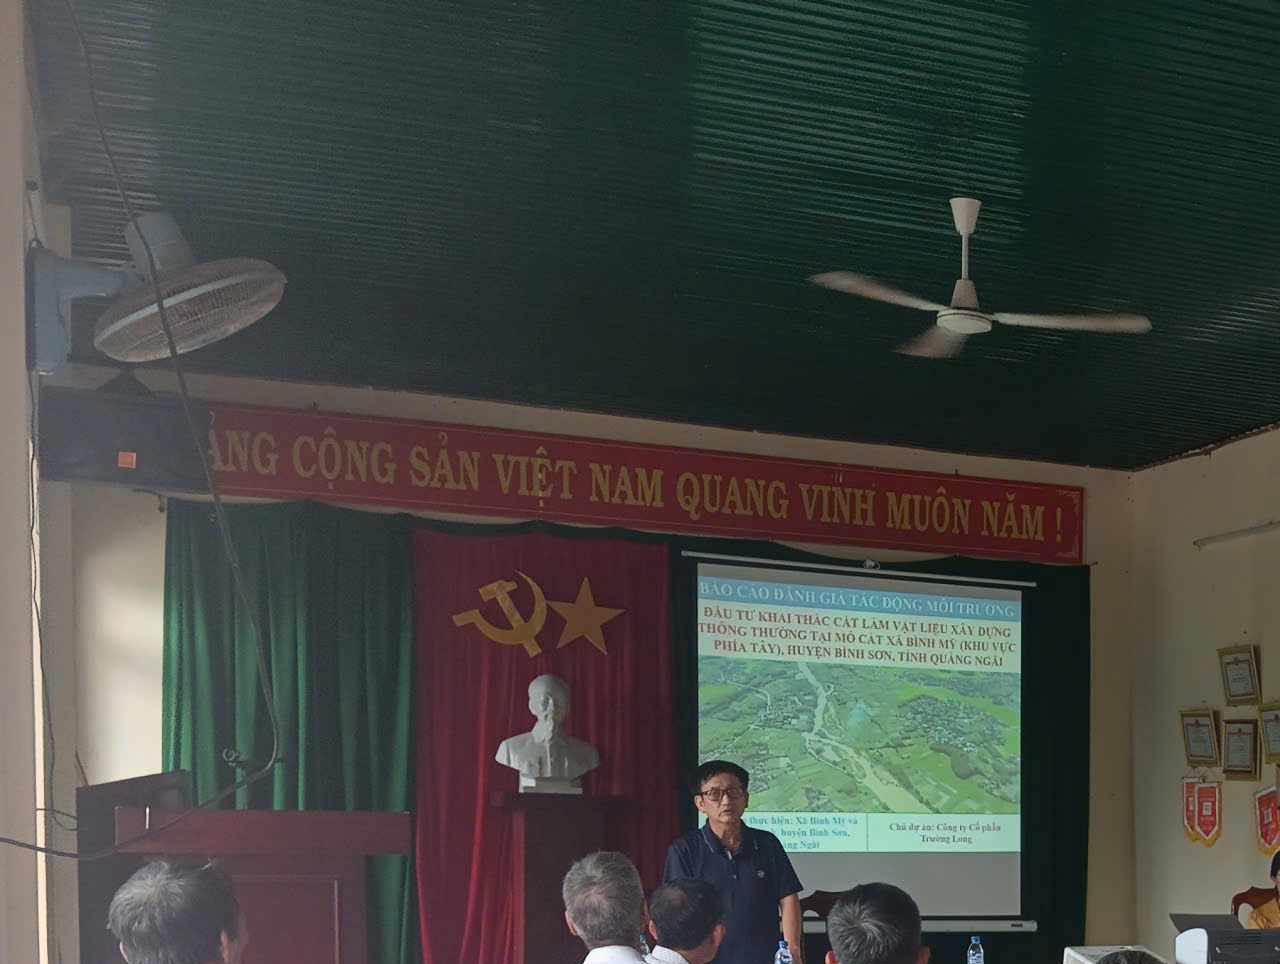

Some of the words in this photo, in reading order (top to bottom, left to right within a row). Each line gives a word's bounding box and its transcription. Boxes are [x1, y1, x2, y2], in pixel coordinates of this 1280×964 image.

[208, 411, 278, 476] ẢNG
[292, 426, 397, 489] CỘNG
[409, 432, 480, 491] SẢN
[492, 446, 577, 508] VIỆT
[588, 463, 665, 507] NAM
[676, 472, 789, 520] QUANG
[799, 483, 875, 526] VINH
[886, 486, 971, 535] MUÔN
[981, 491, 1045, 541] NĂM
[735, 609, 756, 621] TƯ
[759, 611, 791, 624] KHAI
[794, 613, 830, 626] THÁC
[833, 615, 859, 628] CÁT
[862, 617, 889, 630] LÀM
[919, 622, 947, 636] LIỆU
[951, 622, 975, 636] XÂY
[699, 620, 747, 637] THÔNG
[750, 626, 807, 640] THƯỜNG
[809, 631, 831, 644] TẠI
[858, 632, 883, 645] CÁT
[906, 636, 935, 649] BÌNH
[960, 639, 989, 652] (KHU
[992, 641, 1017, 655] VỰC
[714, 639, 747, 653] PHÍA
[787, 645, 831, 660] HUYỆN
[834, 646, 864, 659] BÌNH
[930, 652, 971, 665] QUẢNG
[920, 835, 950, 844] Trường
[952, 835, 972, 844] Long
[936, 823, 958, 832] Công
[959, 824, 967, 832] ty
